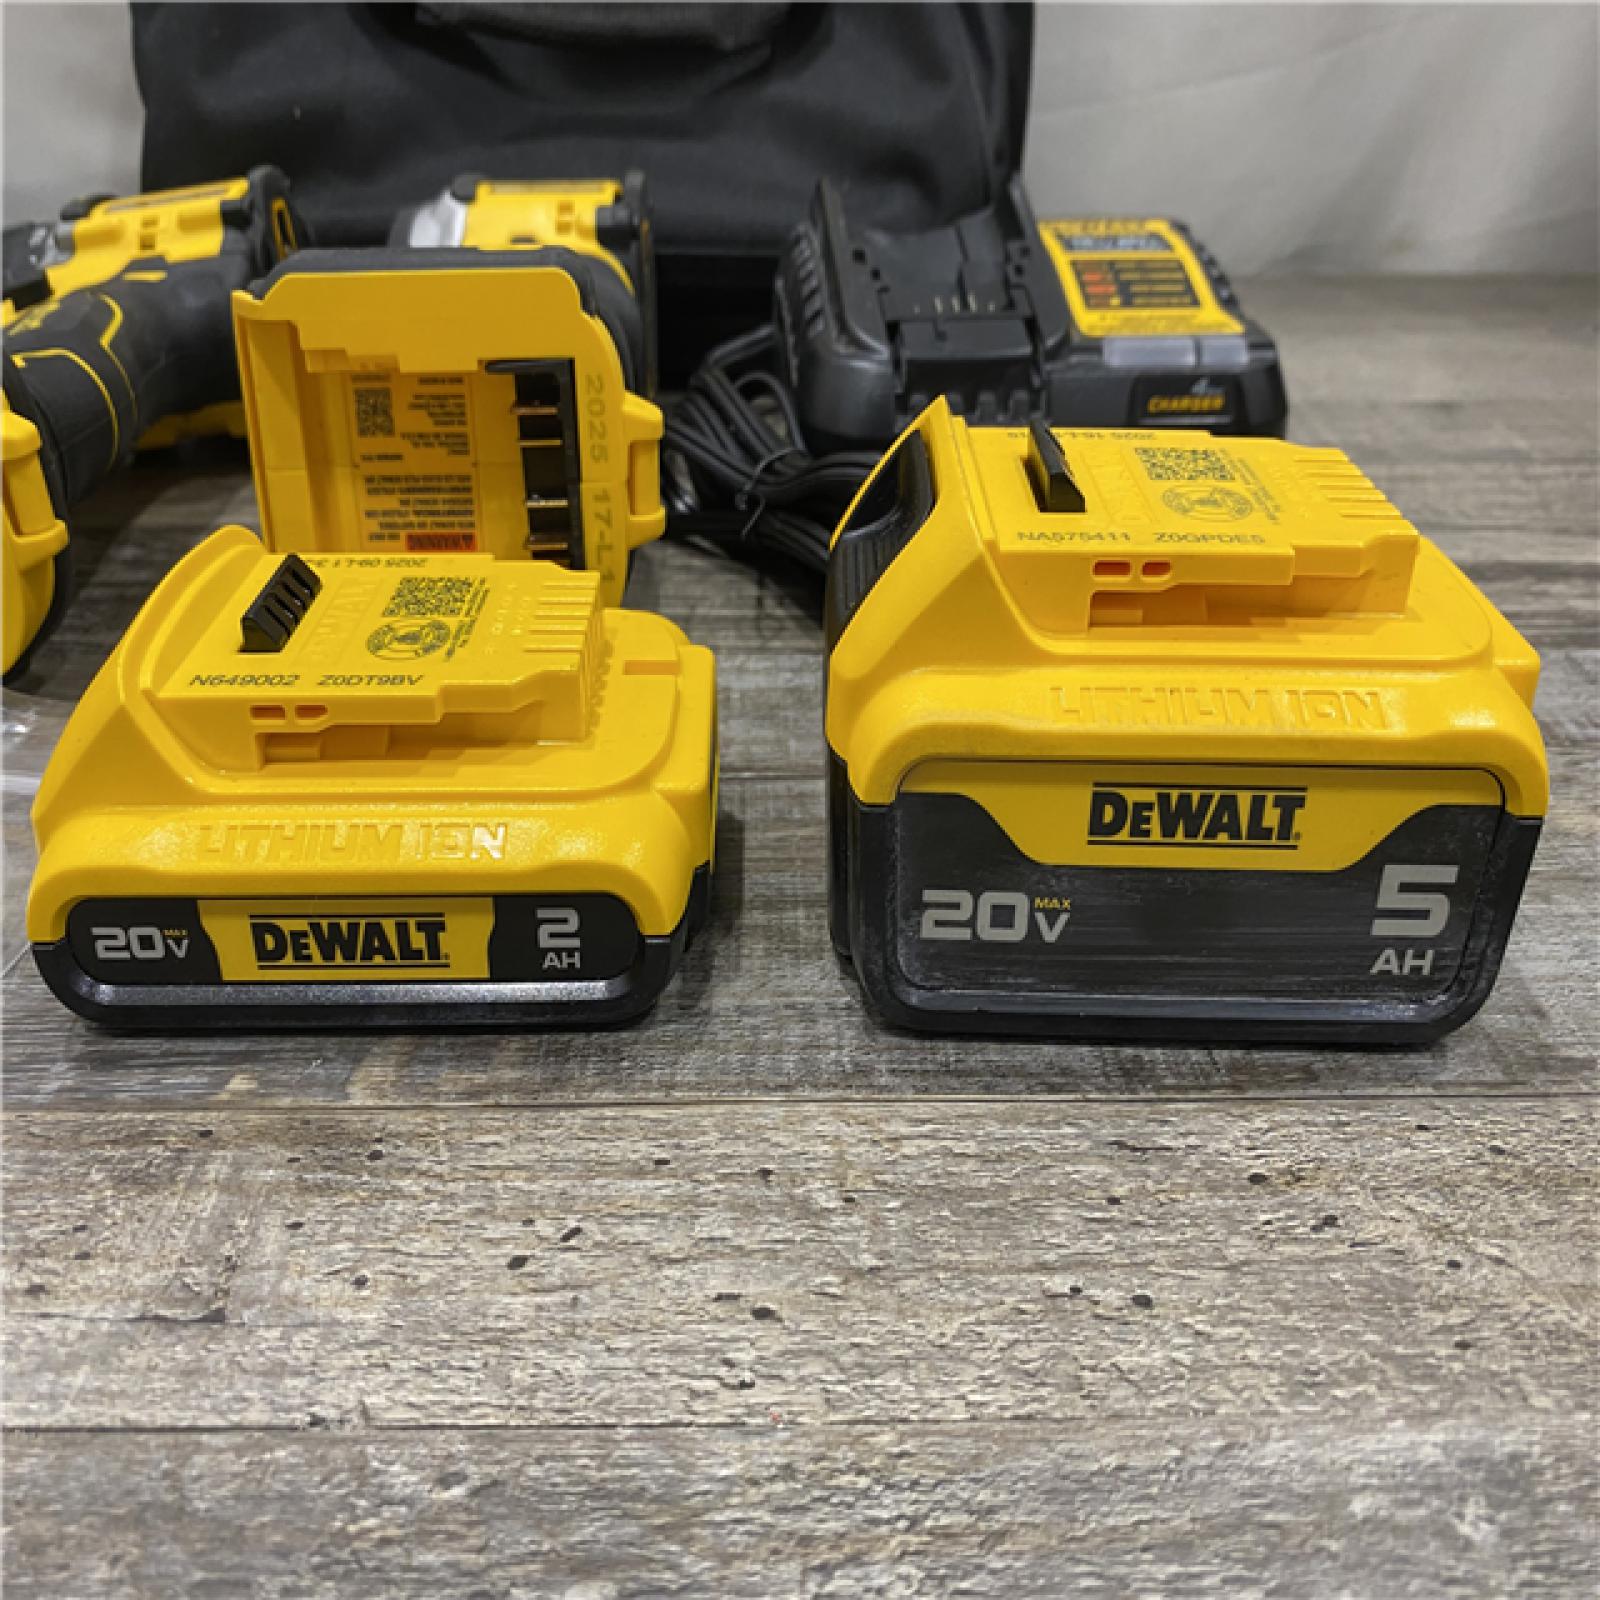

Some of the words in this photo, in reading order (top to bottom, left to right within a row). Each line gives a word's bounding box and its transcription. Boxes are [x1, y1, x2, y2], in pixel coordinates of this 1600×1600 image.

[586, 374, 608, 462] 2025
[1048, 686, 1277, 726] LITHIUM
[1283, 688, 1394, 730] ION
[196, 822, 404, 863] LITHIUM
[415, 822, 508, 863] ION
[1033, 897, 1072, 910] MAX
[1370, 864, 1460, 938] 5
[536, 908, 581, 948] 2
[542, 951, 581, 969] AH
[1369, 949, 1435, 976] AH
